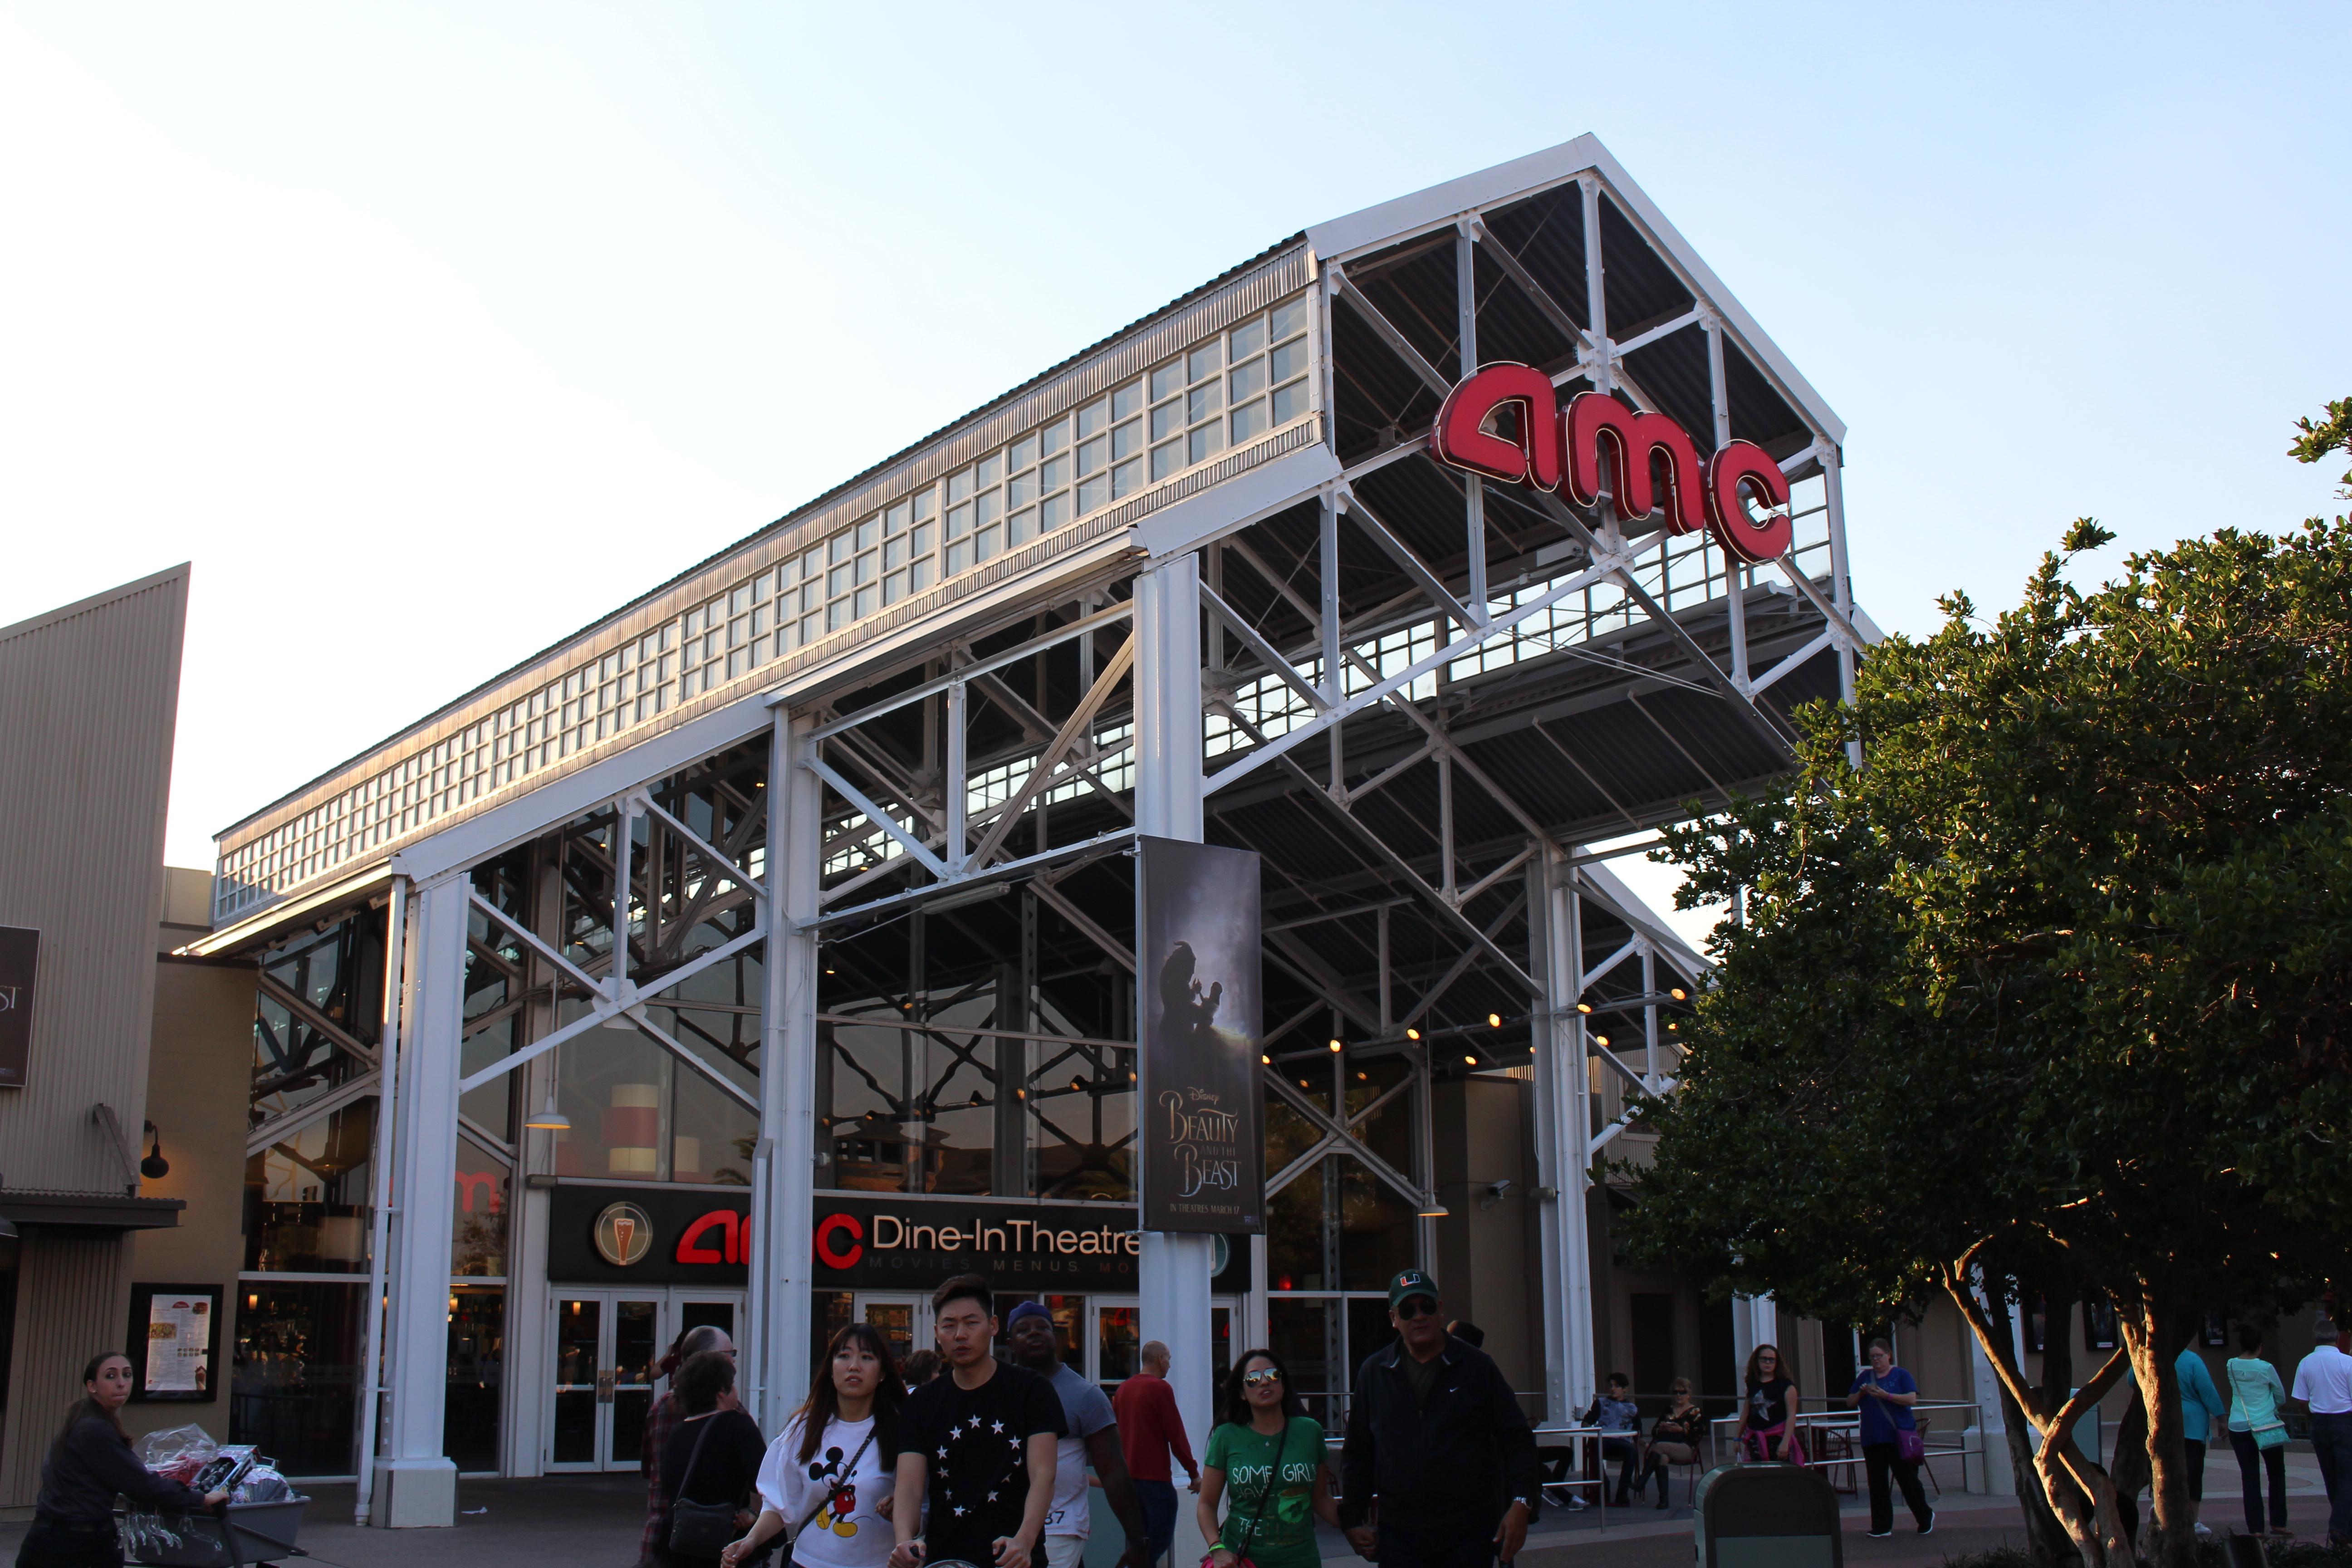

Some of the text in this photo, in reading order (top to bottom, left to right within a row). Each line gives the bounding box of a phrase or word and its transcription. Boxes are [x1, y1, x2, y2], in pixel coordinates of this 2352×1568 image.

[1200, 1146, 1219, 1156] AND
[1170, 1204, 1240, 1215] IN THEATRES MARCH 17
